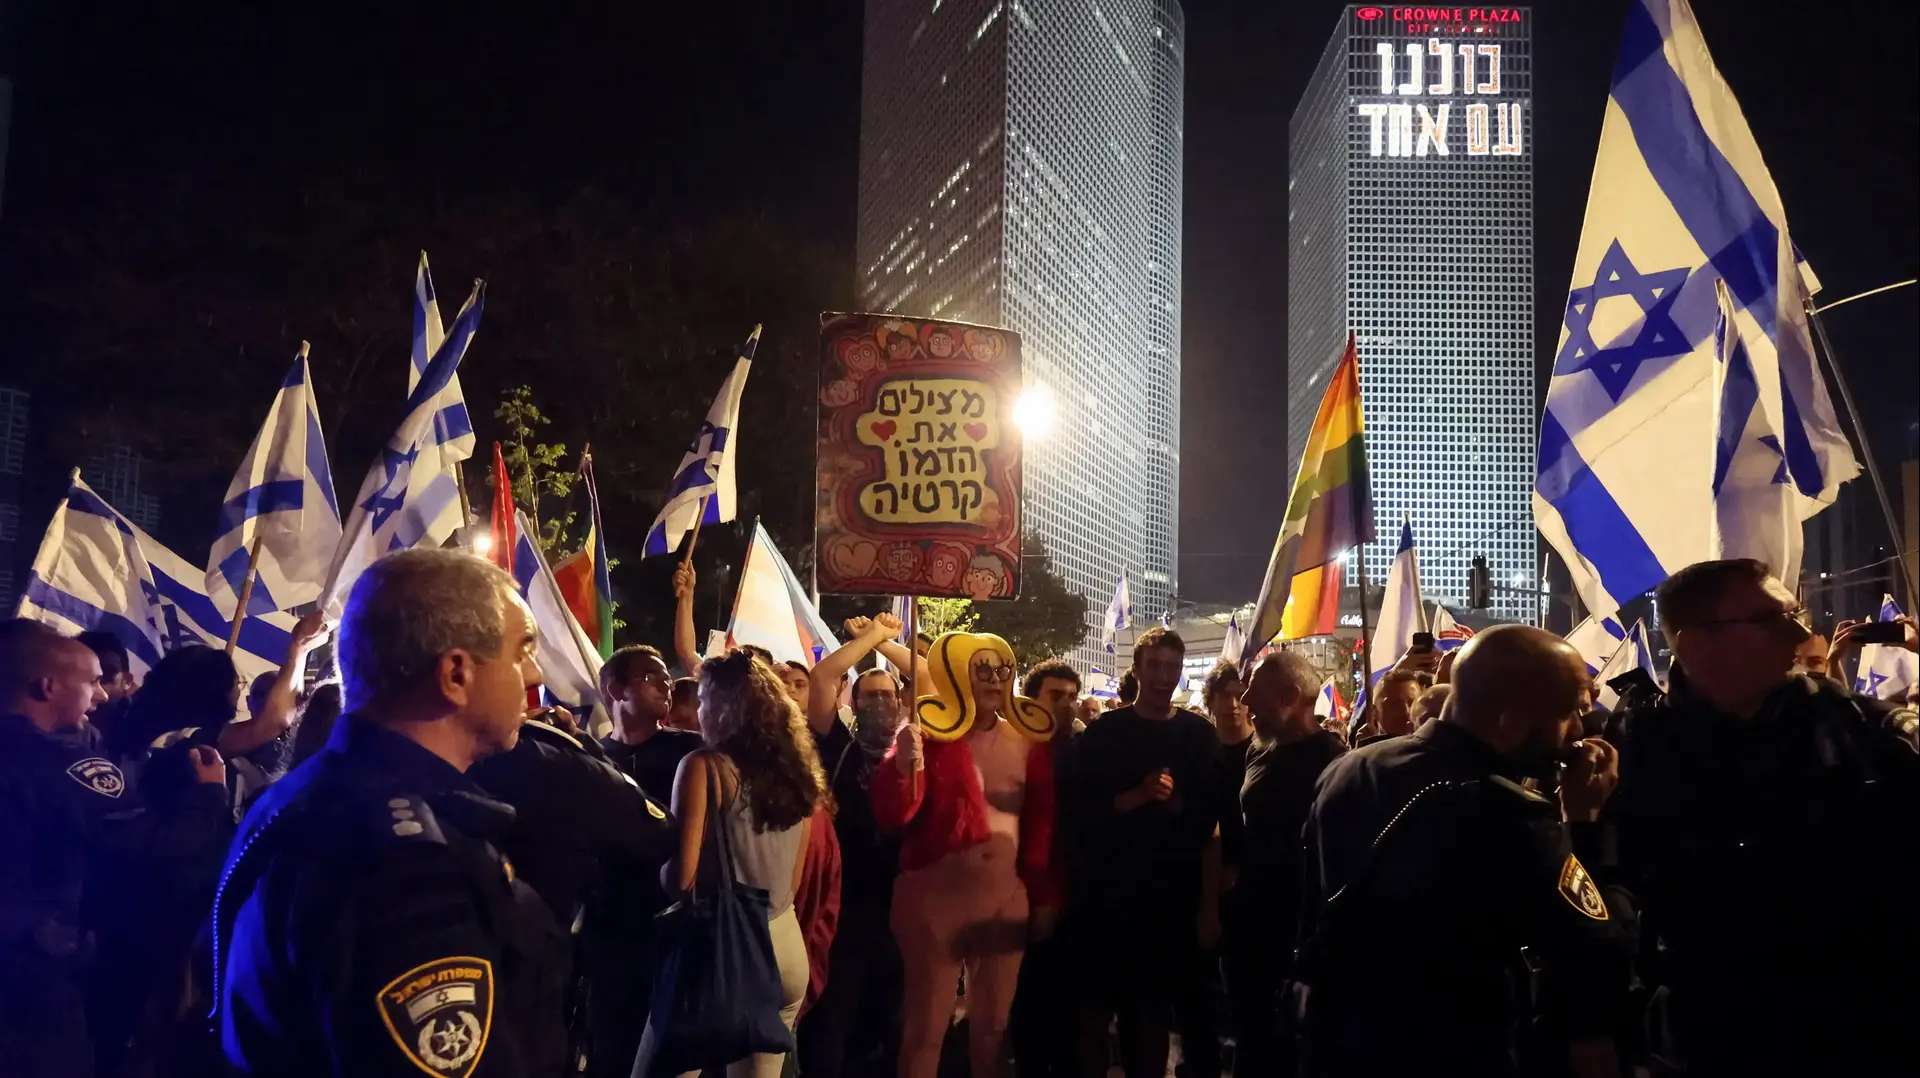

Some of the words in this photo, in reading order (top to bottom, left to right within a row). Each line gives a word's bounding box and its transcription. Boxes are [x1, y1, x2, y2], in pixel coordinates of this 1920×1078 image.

[1393, 8, 1462, 21] CROWNE
[1469, 8, 1521, 22] PLAZA
[1377, 38, 1501, 95] כולנו
[1358, 103, 1450, 157] אחד
[1466, 102, 1522, 156] עם
[879, 382, 985, 418] מצילים
[906, 421, 956, 443] את
[873, 479, 982, 520] קרטיה
